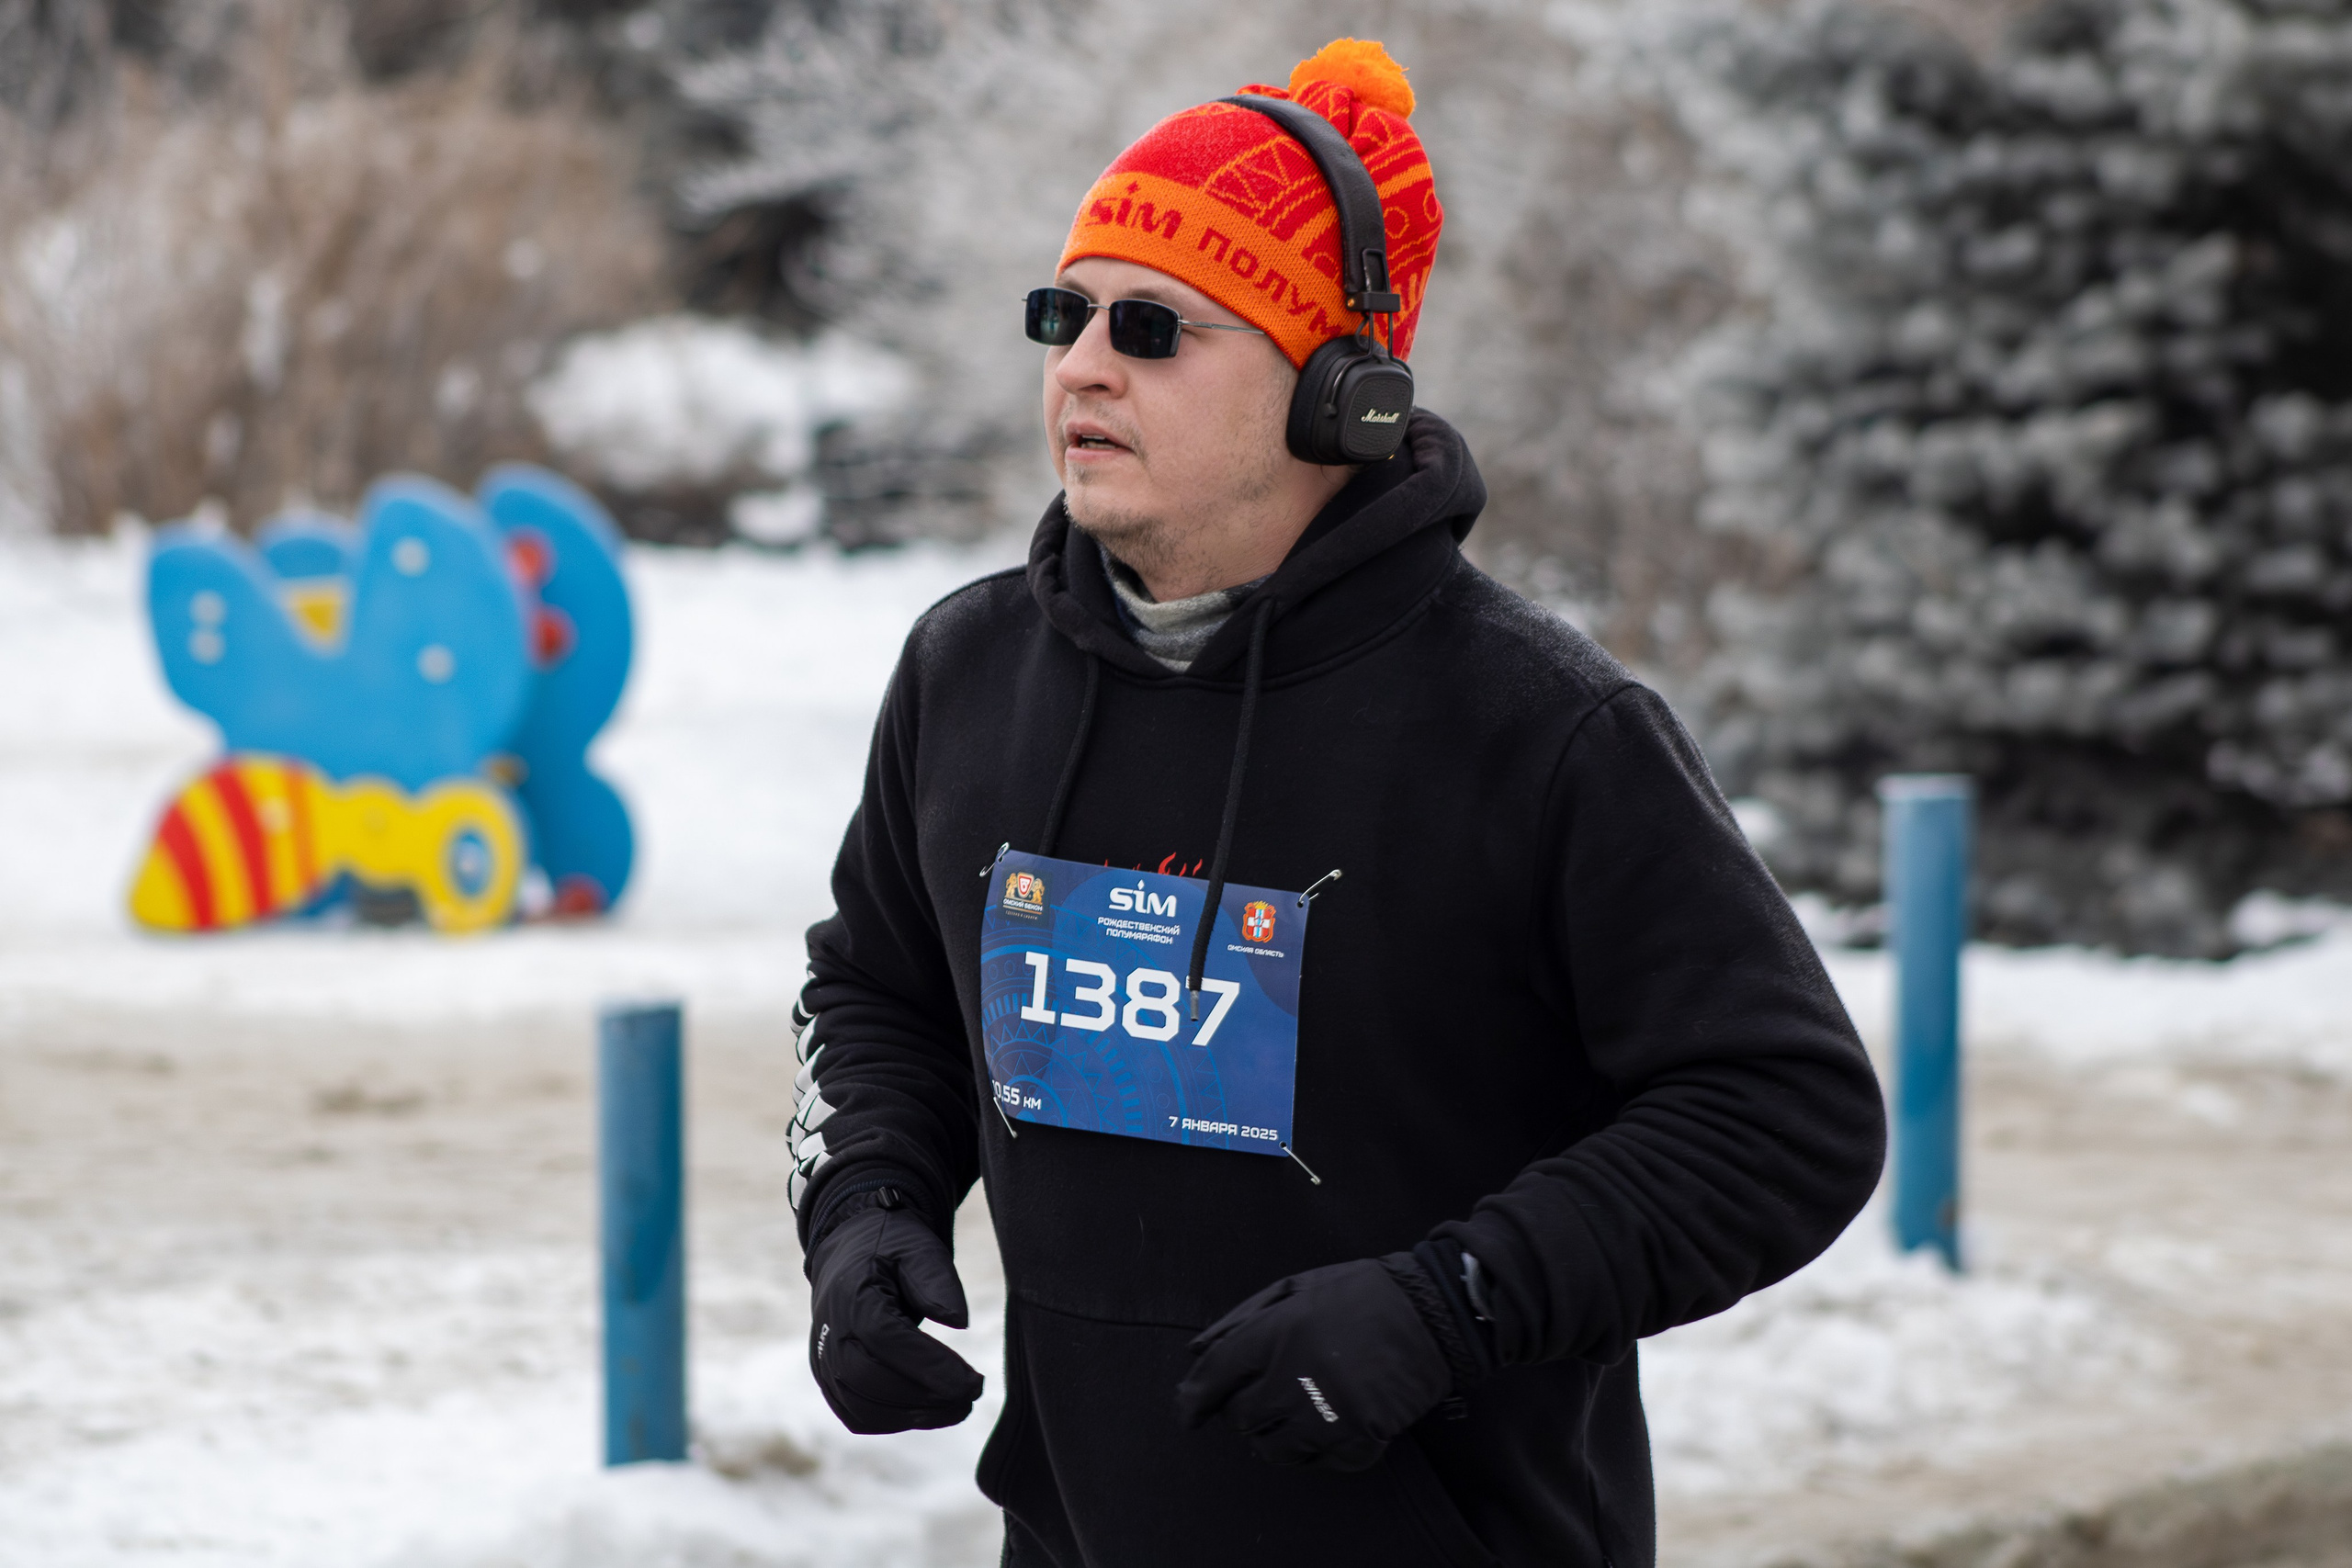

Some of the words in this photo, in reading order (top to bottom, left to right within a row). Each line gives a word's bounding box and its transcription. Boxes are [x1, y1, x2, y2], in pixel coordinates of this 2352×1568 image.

[1361, 408, 1399, 423] Marshall
[1097, 916, 1181, 936] РОЖДЕСТВЕНСКИЙ
[1105, 928, 1173, 945] ПОЛУМАРАФОН
[1227, 943, 1254, 954] ОМСКАЯ
[1254, 948, 1284, 958] ОБЛАСТЬ
[1021, 951, 1240, 1046] 1387
[1168, 1115, 1179, 1128] 7
[1182, 1118, 1238, 1135] ЯНВАРЯ
[1240, 1125, 1278, 1141] 2025
